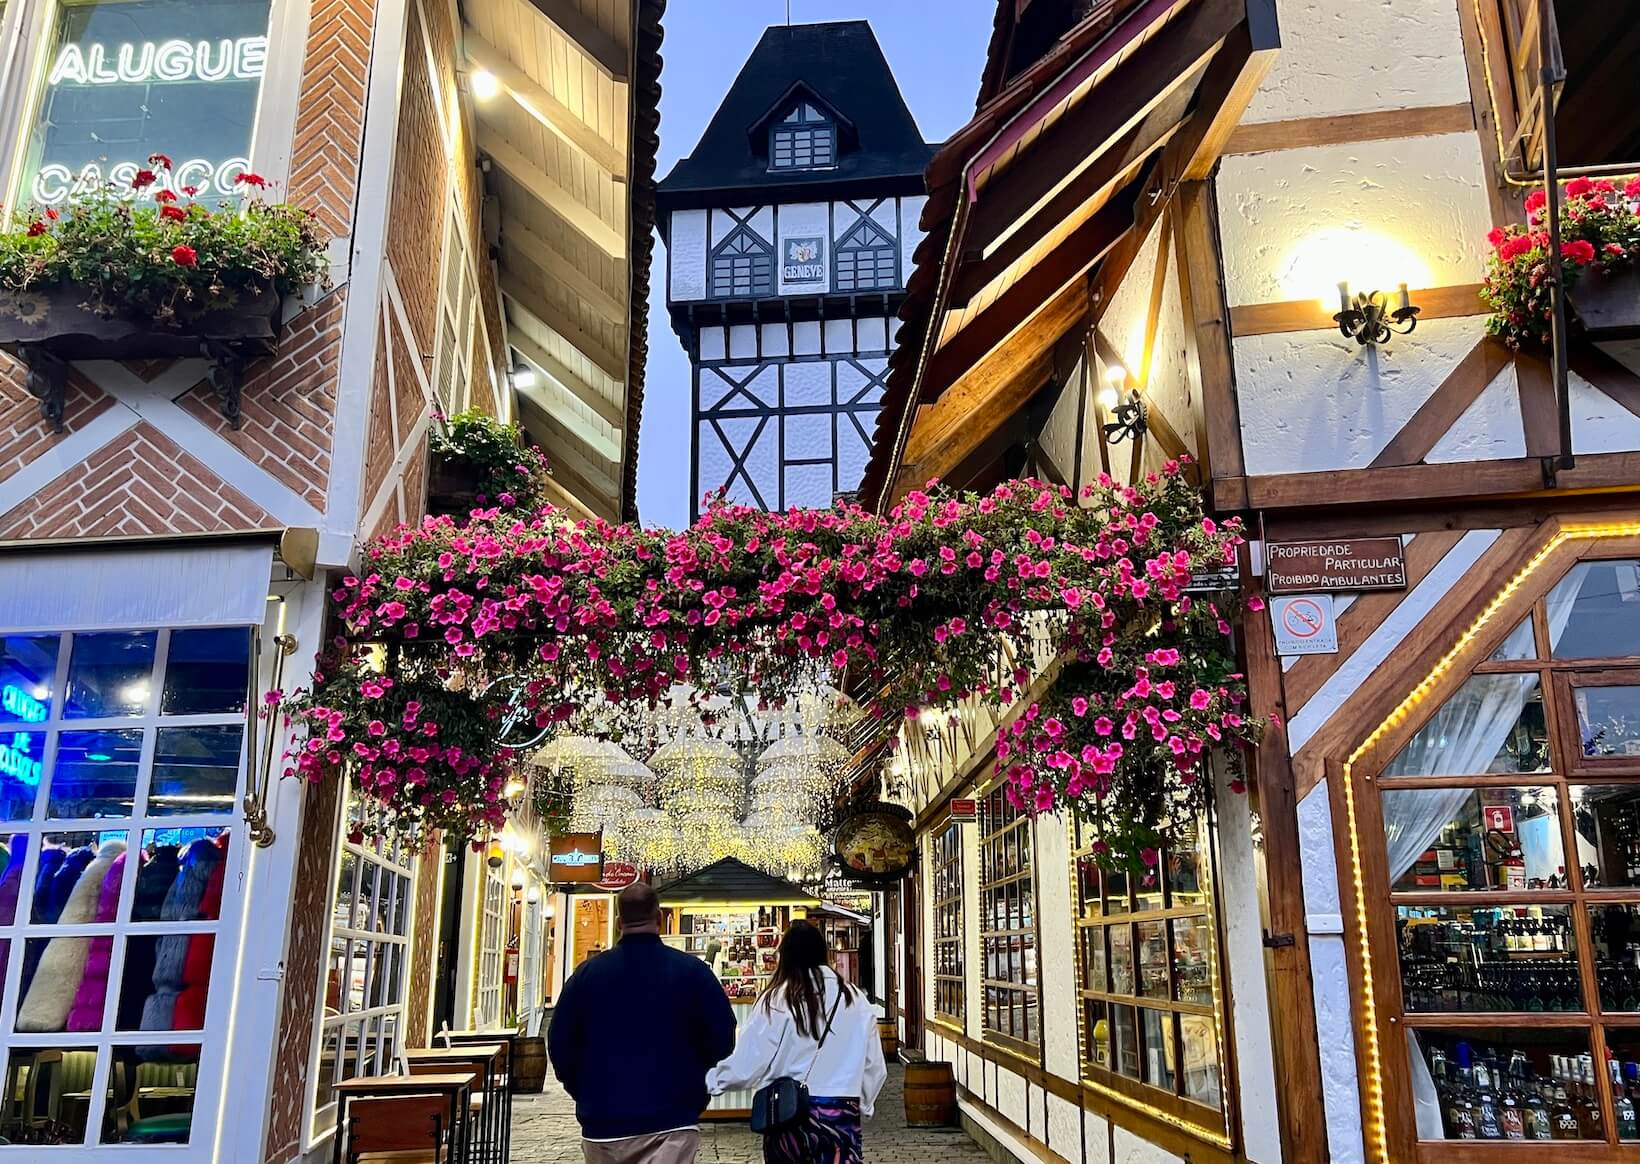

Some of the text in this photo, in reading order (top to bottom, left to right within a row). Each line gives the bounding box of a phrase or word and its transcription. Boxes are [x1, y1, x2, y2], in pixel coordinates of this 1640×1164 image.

[48, 35, 268, 85] ALUGUE
[784, 265, 823, 279] GENEVE
[1270, 544, 1353, 559] PROPRIEDADE
[1325, 557, 1400, 570] PARTICULAR
[1272, 573, 1402, 586] PROIBIDO AMBULANTES
